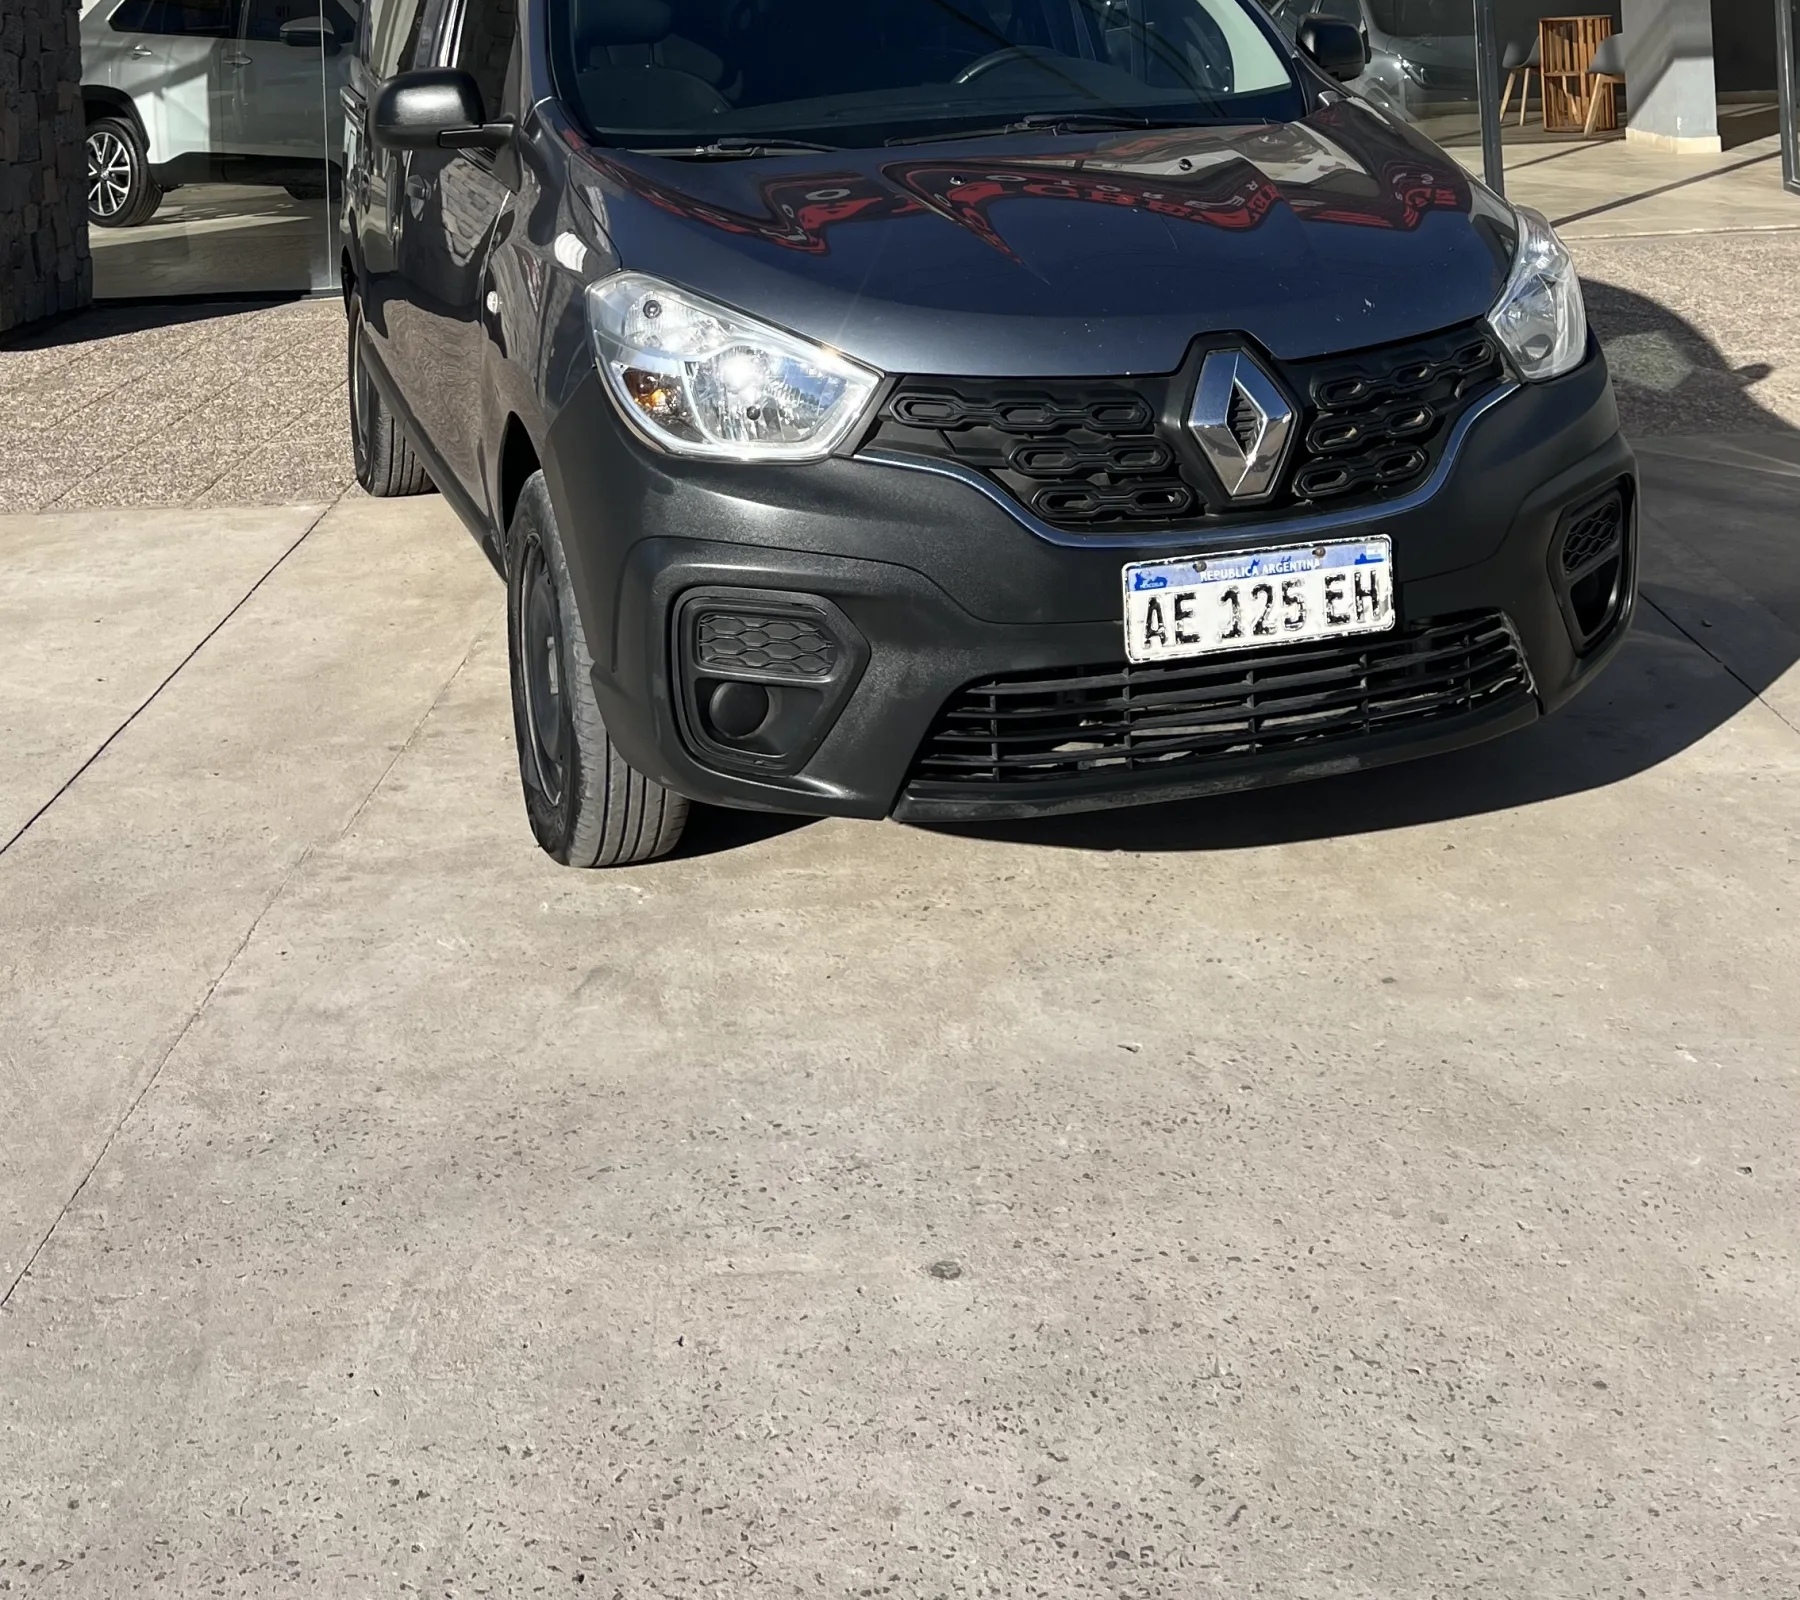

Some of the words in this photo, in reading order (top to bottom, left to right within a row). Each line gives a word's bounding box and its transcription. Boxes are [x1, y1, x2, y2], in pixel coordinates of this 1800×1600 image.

[1262, 558, 1320, 574] ARGENTINA
[1144, 591, 1202, 649] AE
[1217, 578, 1307, 641] 125
[1324, 569, 1380, 626] EH
